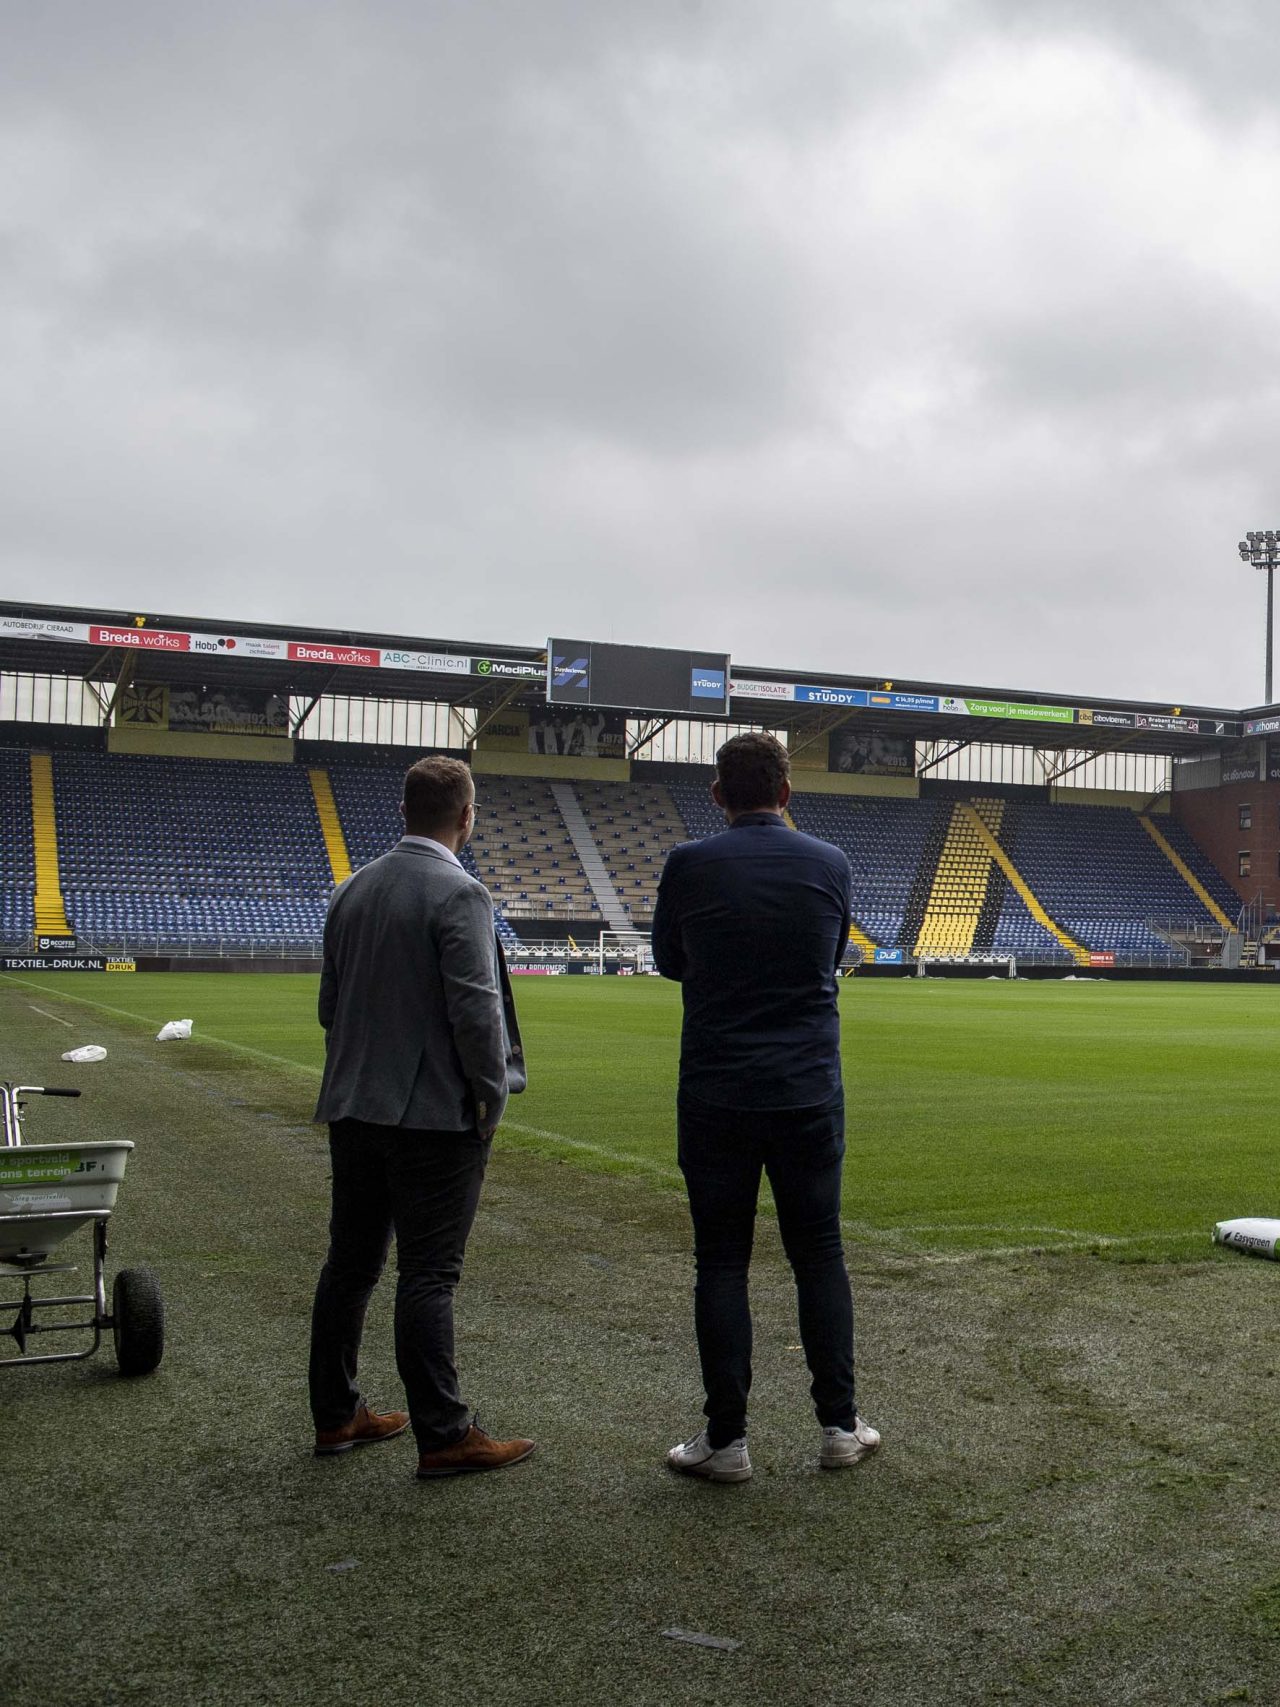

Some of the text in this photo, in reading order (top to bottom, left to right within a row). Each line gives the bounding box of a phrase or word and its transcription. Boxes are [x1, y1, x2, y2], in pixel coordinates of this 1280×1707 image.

[3, 621, 74, 633] AUTOBEDRIJF CIERAAD
[99, 630, 180, 648] Breda.works
[296, 646, 371, 664] Breda.works
[970, 703, 1070, 718] Zorg voor je medewerkers!
[1255, 721, 1280, 732] athome
[6, 958, 104, 970] TEXTIEL-DRUK.NL
[108, 963, 134, 971] DRUK
[1234, 1231, 1271, 1248] Easygreen
